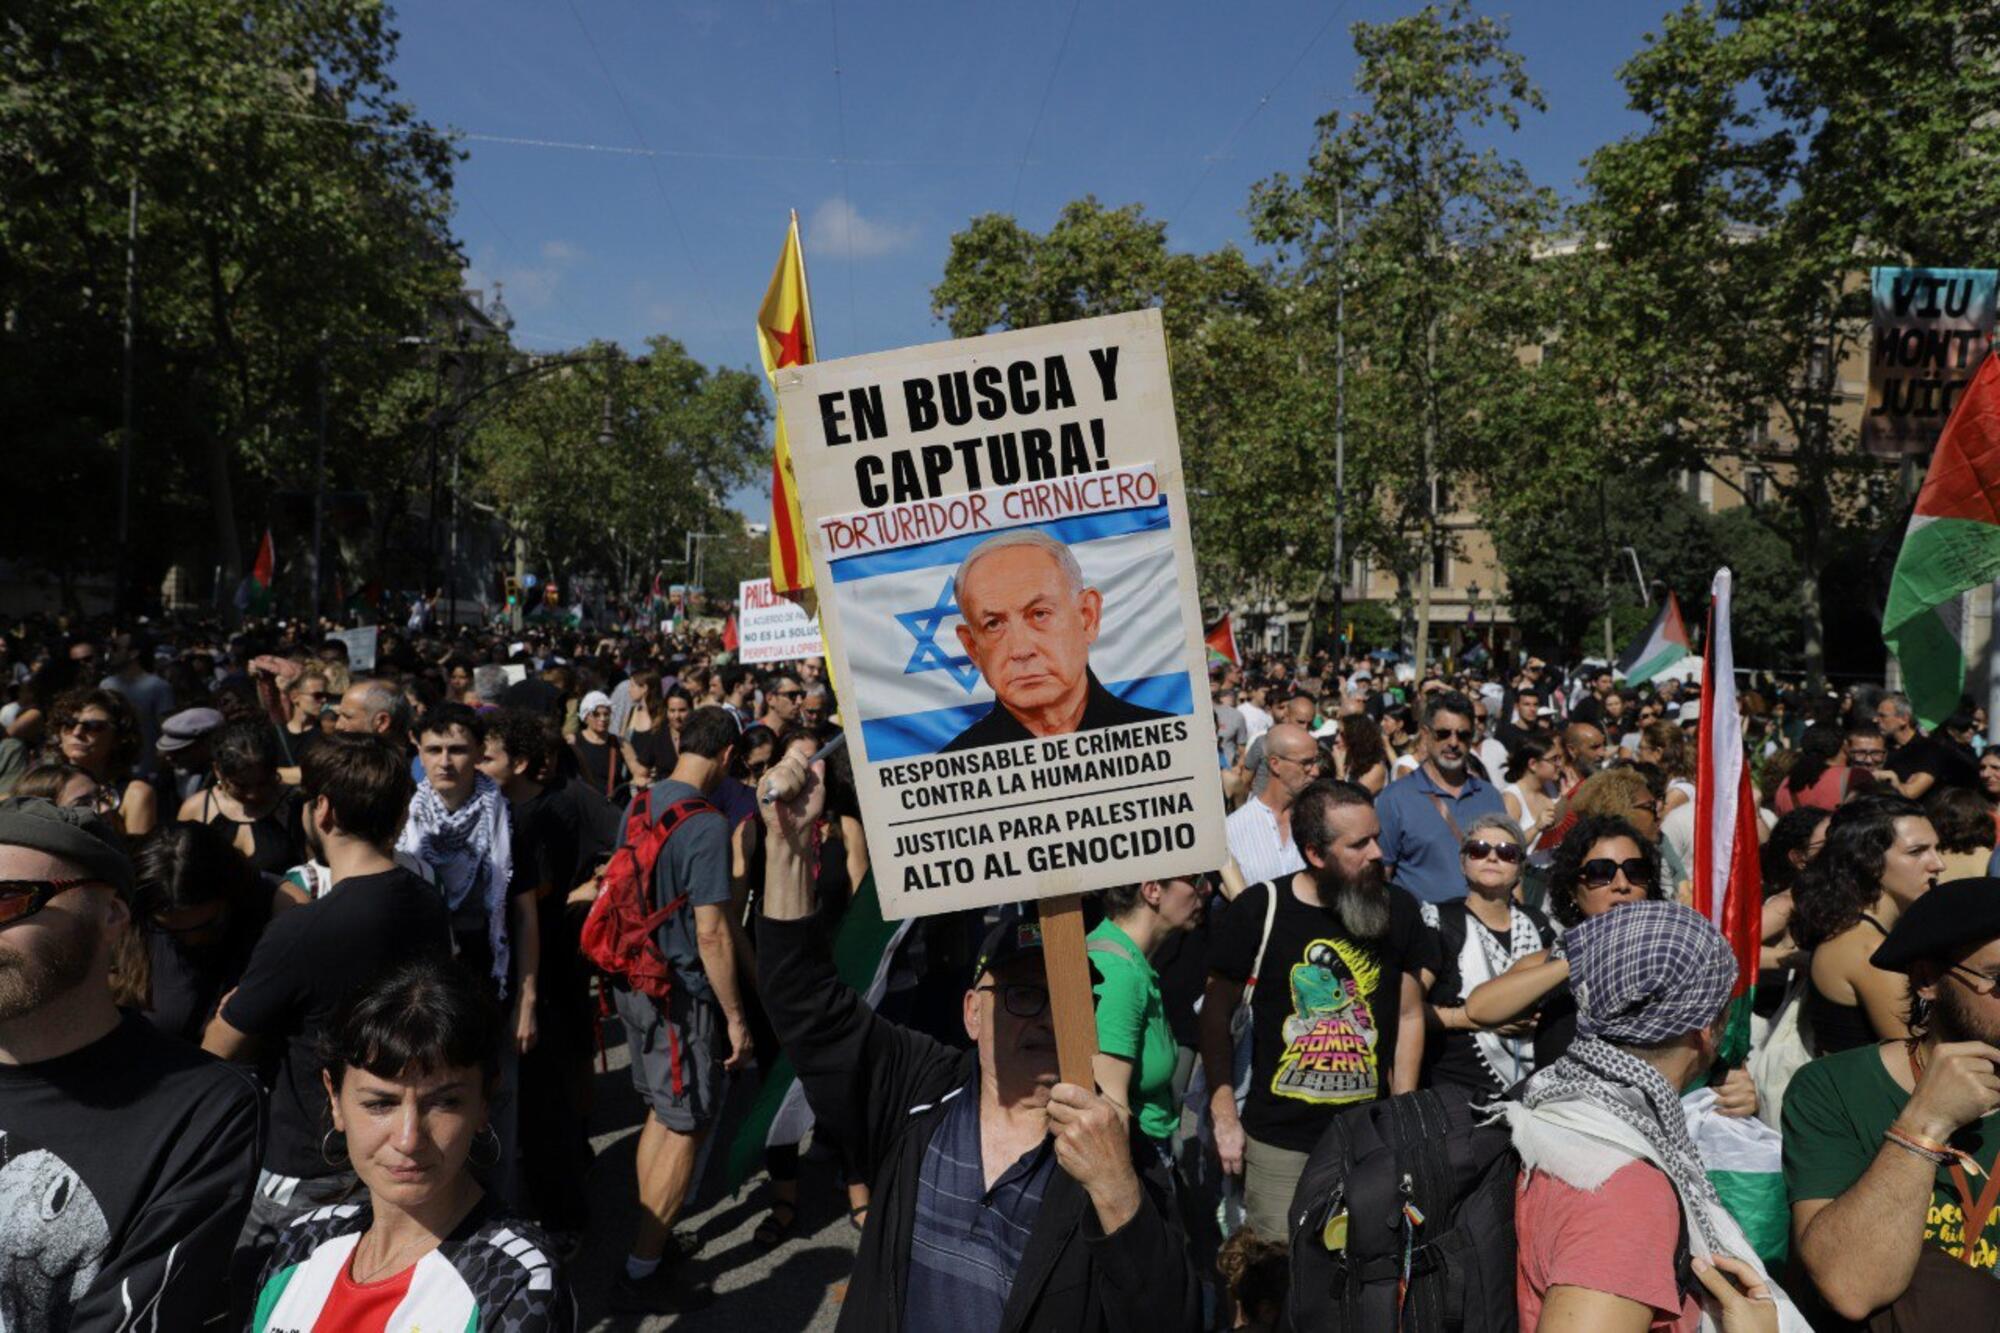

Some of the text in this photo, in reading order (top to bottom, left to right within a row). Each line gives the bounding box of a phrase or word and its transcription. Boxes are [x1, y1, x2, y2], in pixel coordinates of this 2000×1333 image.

[1893, 277, 1974, 319] VIU
[1875, 328, 1981, 369] MONT
[818, 346, 1120, 447] EN BUSCA Y
[854, 418, 1110, 509] CAPTURA!
[820, 472, 1157, 554] TORTURADOR CARNICERO
[743, 645, 784, 659] PERPETUA
[785, 644, 796, 656] LA
[744, 624, 819, 642] NO ES LA SOLUC
[879, 720, 1188, 788] RESPONSABLE DE CRÍMENES
[901, 749, 1172, 810] CONTRA LA HUMANIDAD
[893, 792, 1195, 858] JUSTICIA PARA PALESTINA
[903, 822, 1197, 893] ALTO AL GENOCIDIO
[1290, 1034, 1371, 1056] ROMPE
[1310, 1019, 1356, 1037] SON
[1297, 1051, 1369, 1073] PERA
